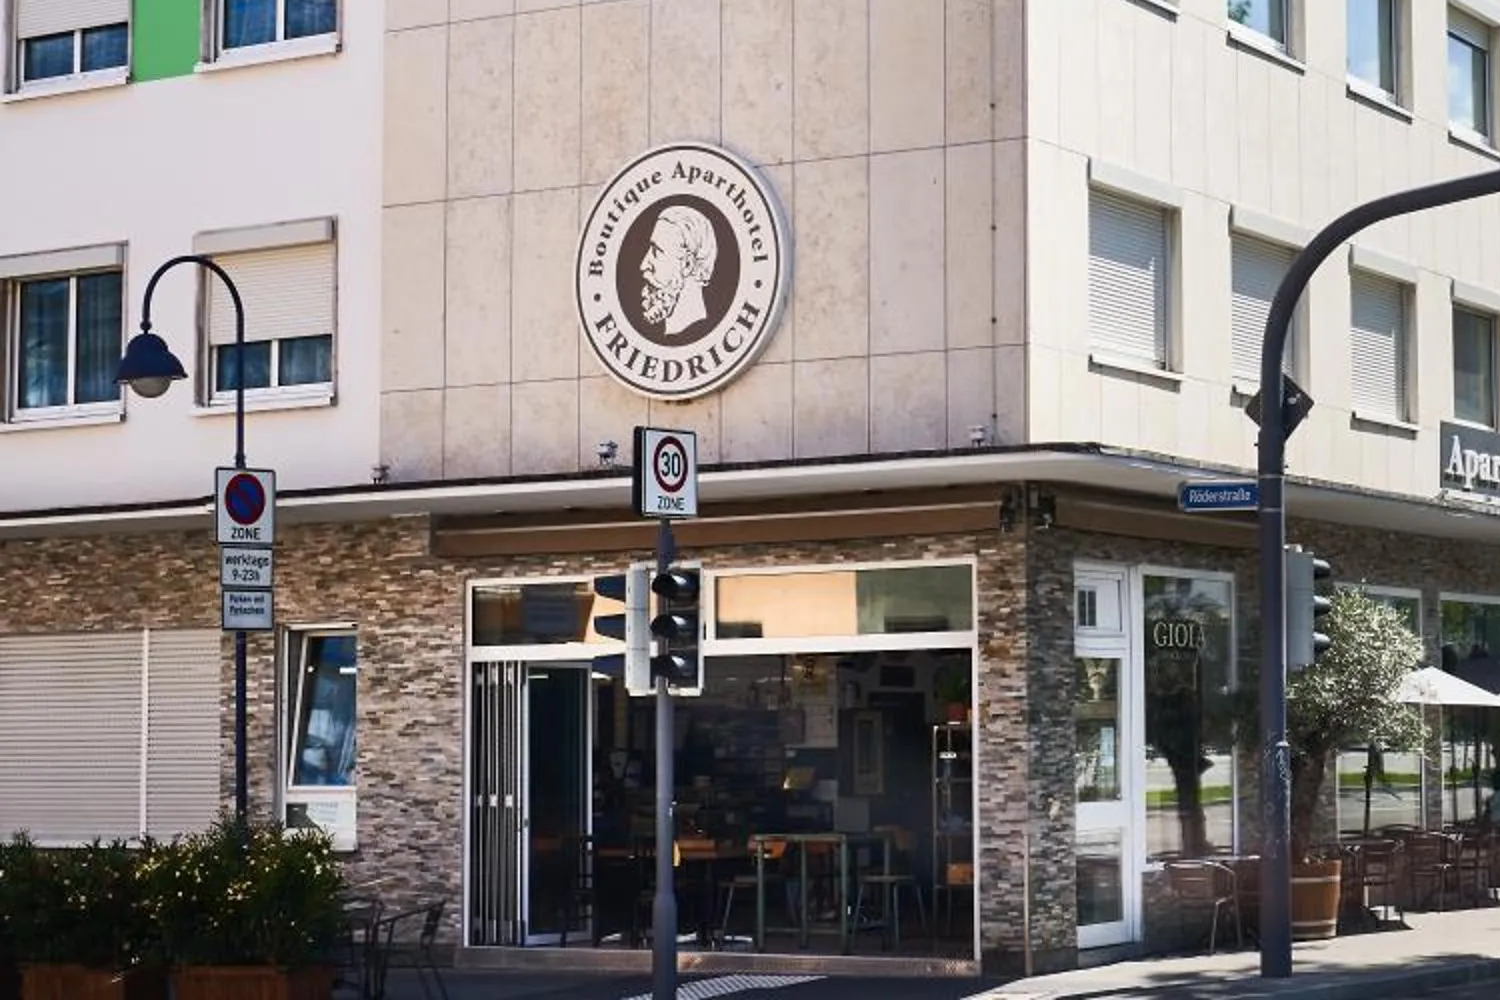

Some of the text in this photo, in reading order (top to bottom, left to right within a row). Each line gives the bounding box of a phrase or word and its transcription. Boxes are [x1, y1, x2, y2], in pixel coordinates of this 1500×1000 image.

[588, 160, 769, 277] Boutique Aparthotel
[594, 300, 761, 383] FRIEDRICH
[661, 451, 682, 478] 30
[657, 495, 685, 511] ZONE
[231, 527, 261, 541] ZONE
